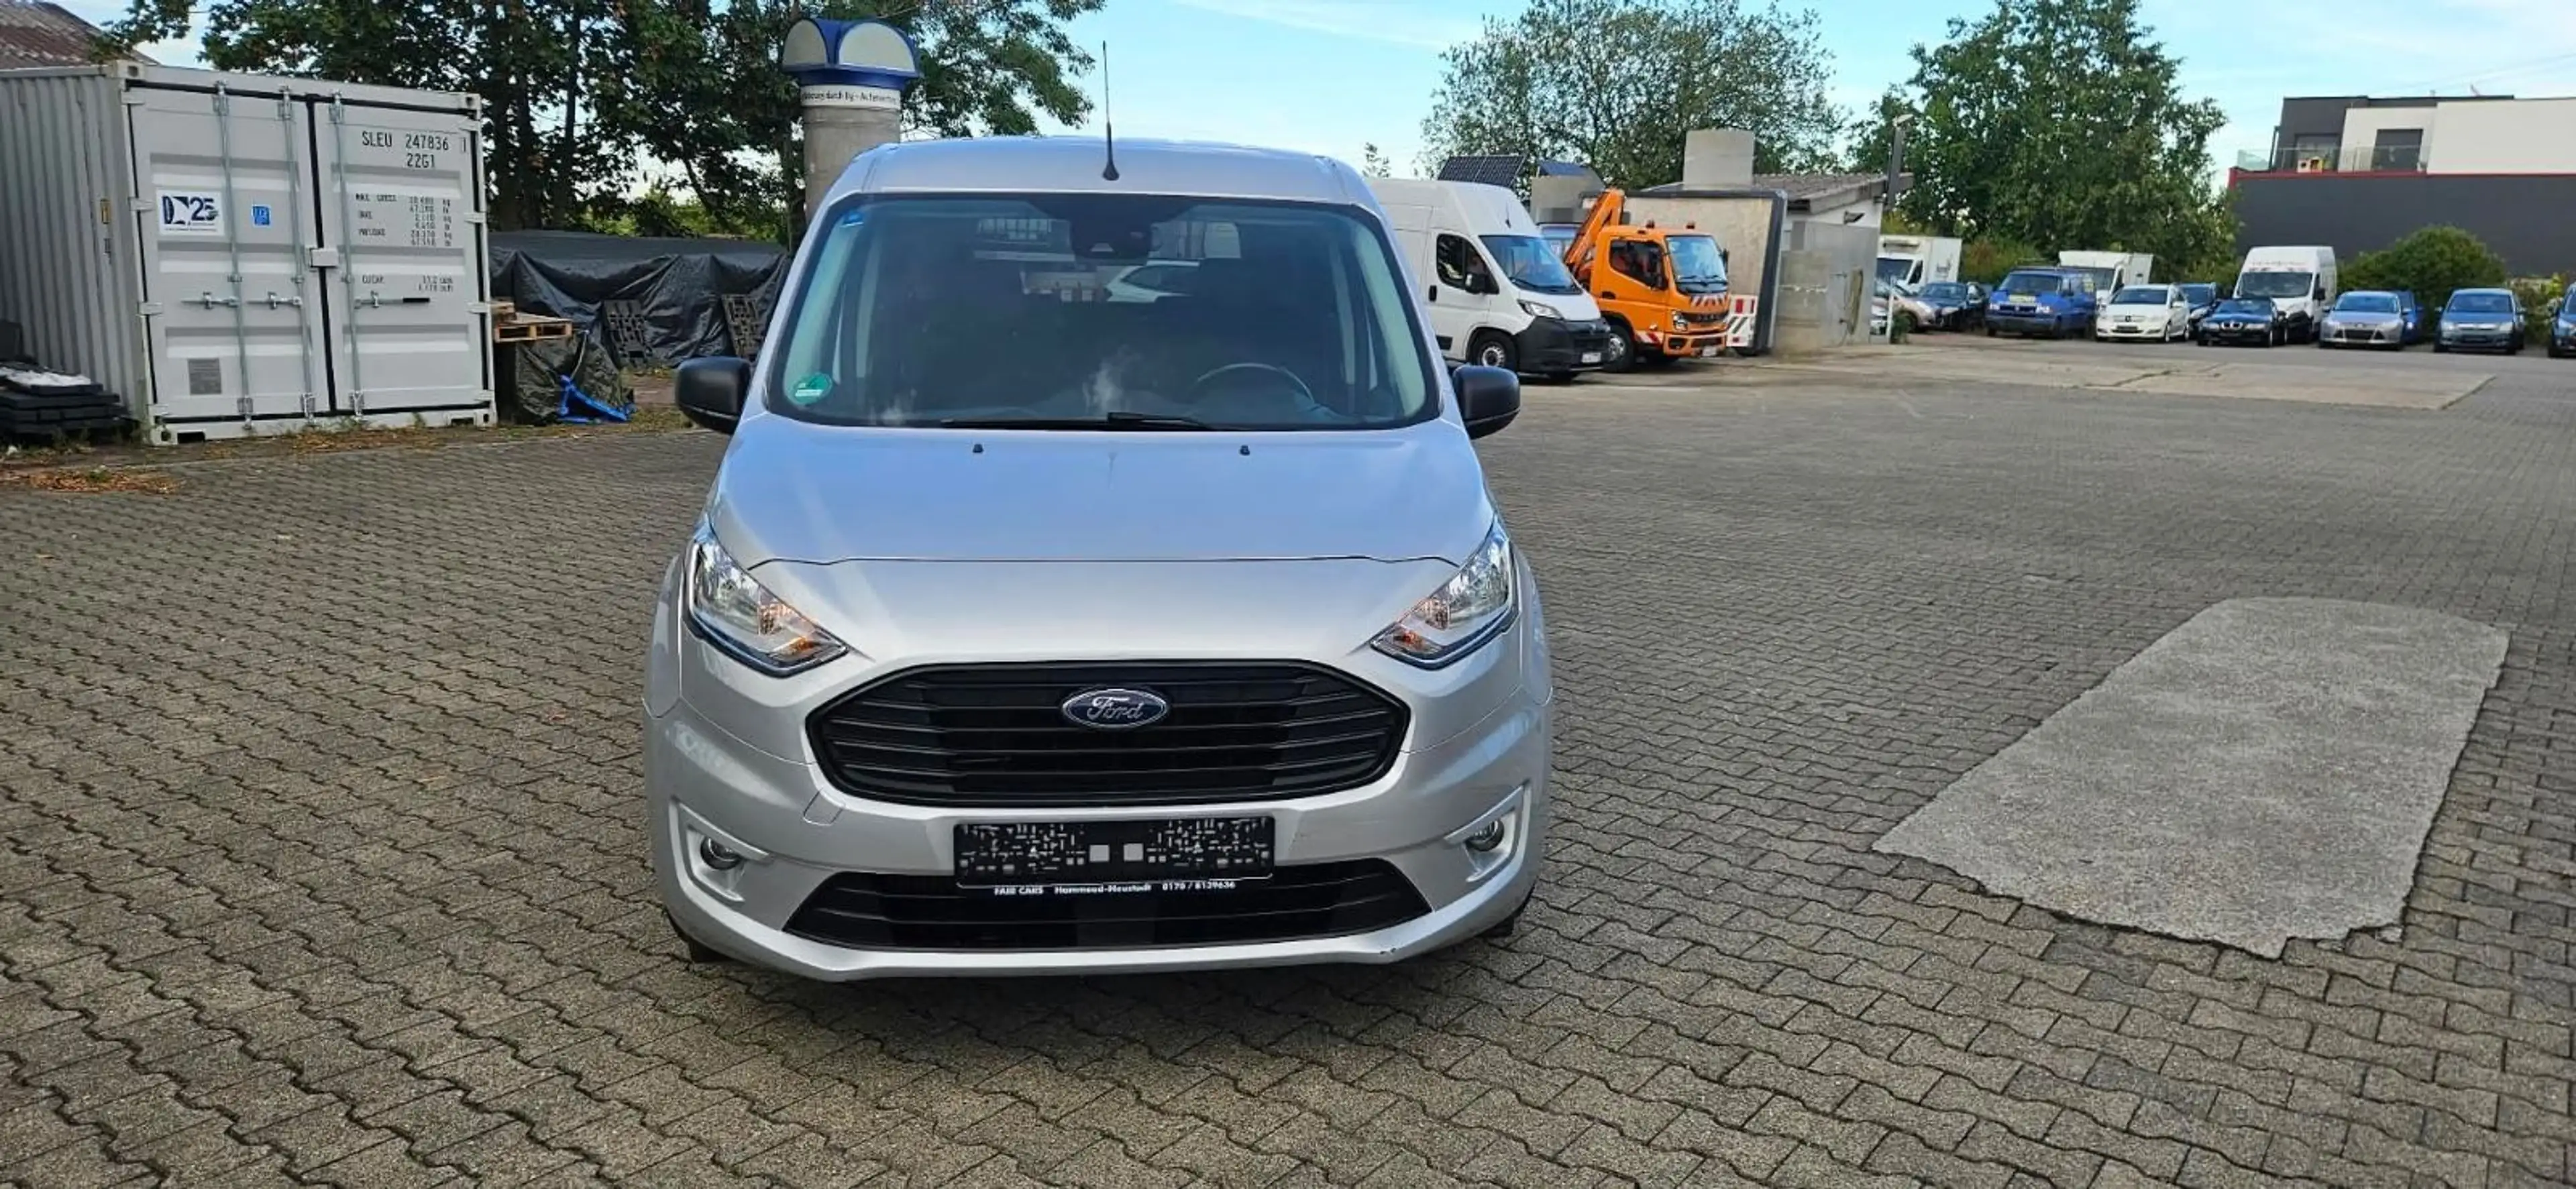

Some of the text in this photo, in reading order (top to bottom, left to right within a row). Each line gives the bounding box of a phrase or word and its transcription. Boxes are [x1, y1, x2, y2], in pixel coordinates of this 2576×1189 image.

[362, 130, 392, 148] SLEU
[405, 134, 449, 151] 247836
[407, 153, 435, 168] 22G1
[1087, 696, 1144, 720] Ford
[1162, 882, 1186, 891] 0170
